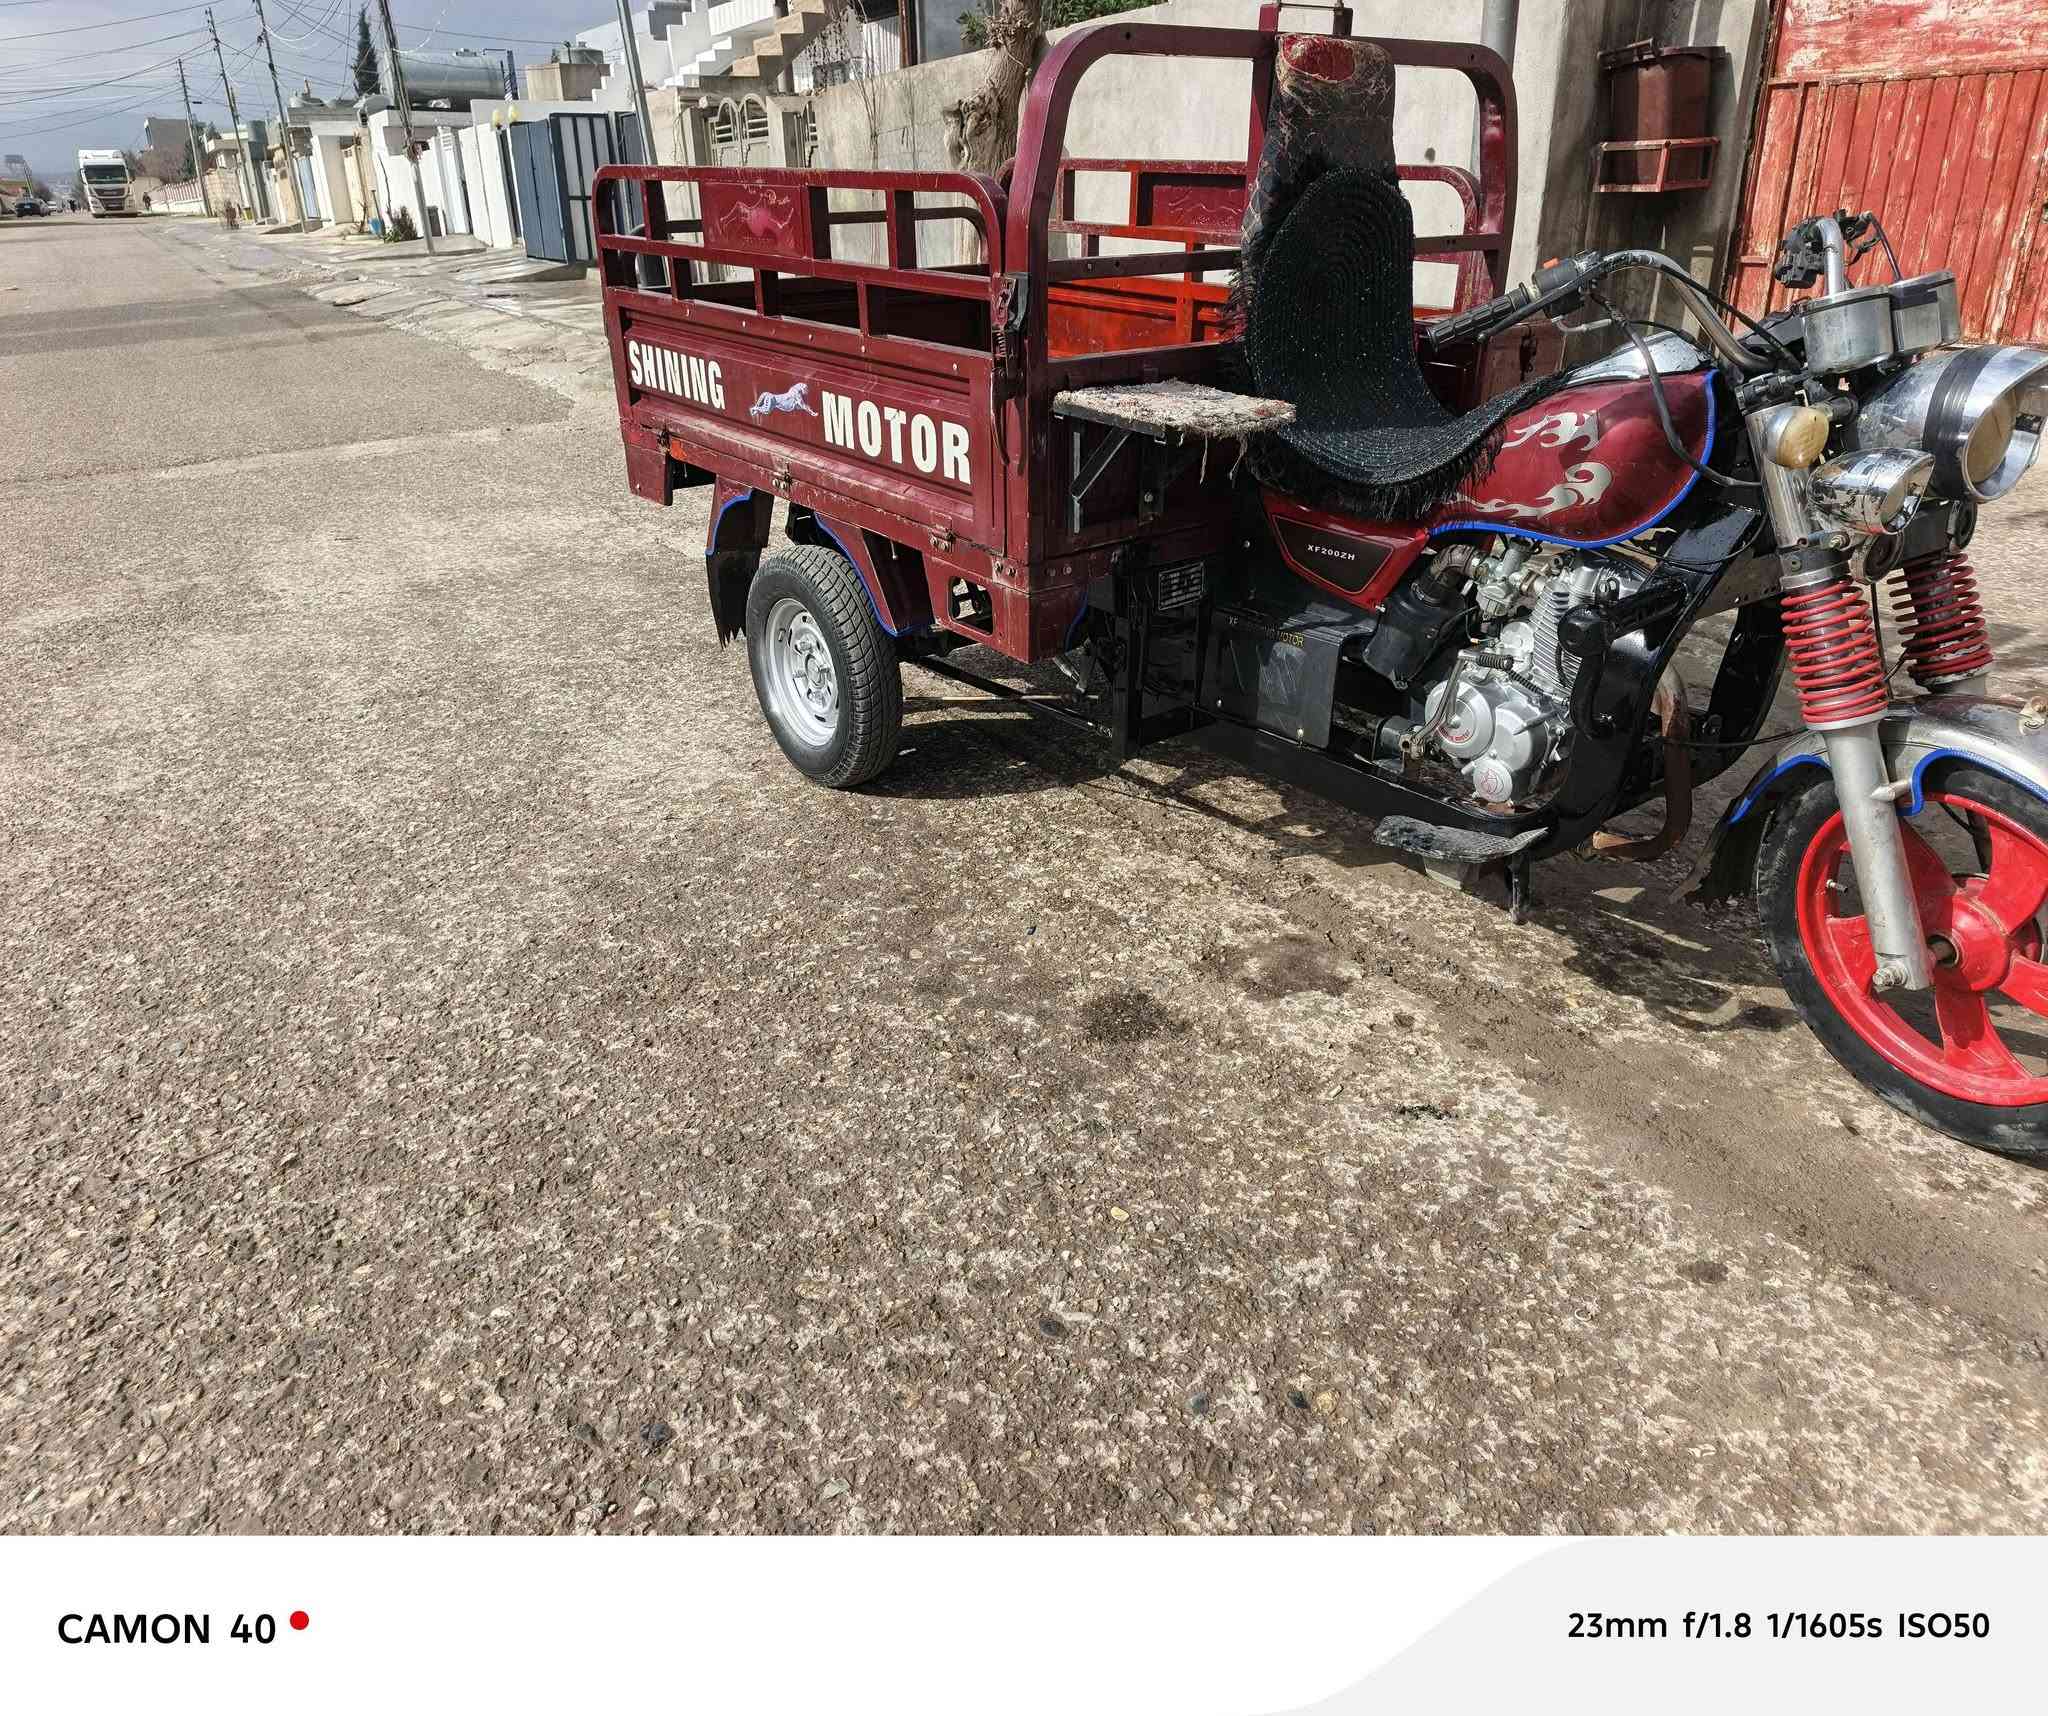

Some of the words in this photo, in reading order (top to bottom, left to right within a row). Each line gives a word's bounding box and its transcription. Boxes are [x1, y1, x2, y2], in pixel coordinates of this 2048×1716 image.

[628, 340, 726, 410] SHINING
[821, 390, 972, 485] MOTOR
[1307, 544, 1356, 561] XF200ZH
